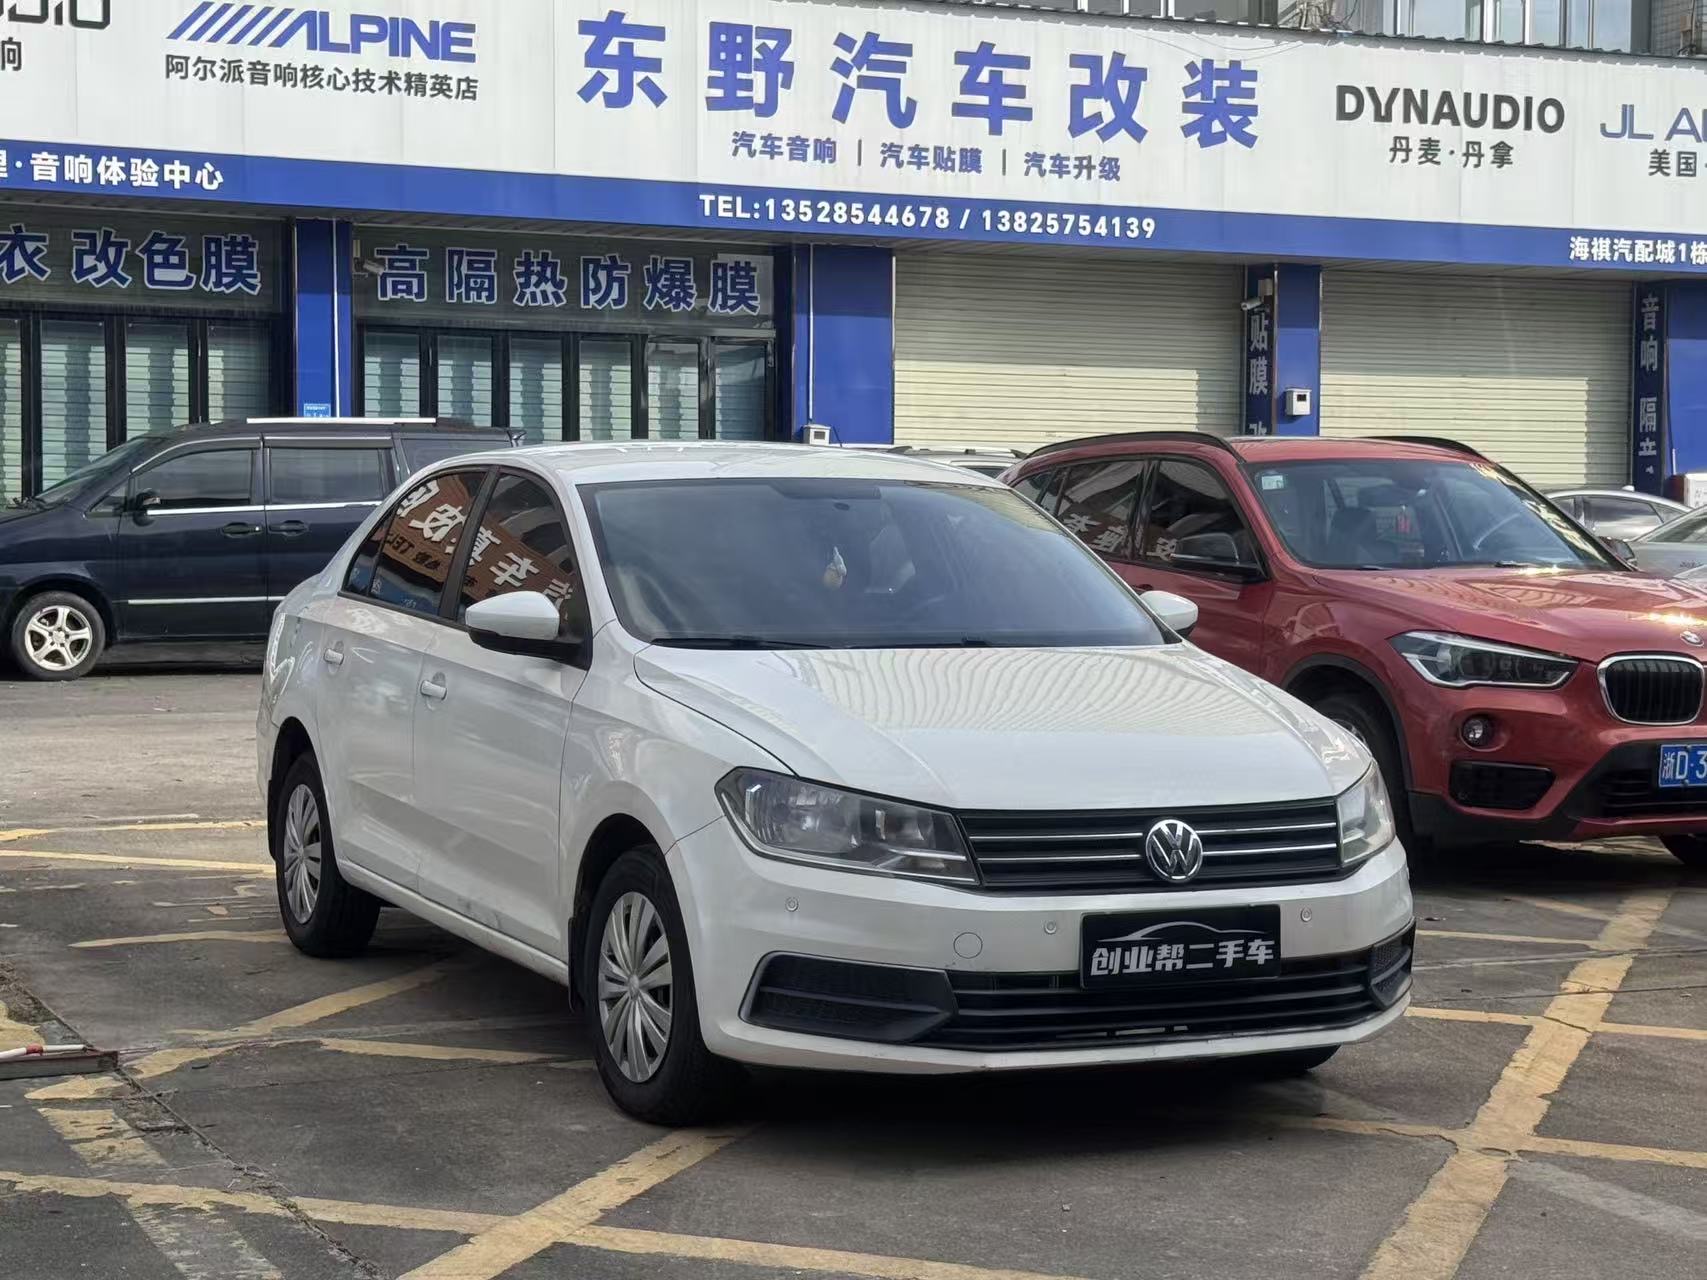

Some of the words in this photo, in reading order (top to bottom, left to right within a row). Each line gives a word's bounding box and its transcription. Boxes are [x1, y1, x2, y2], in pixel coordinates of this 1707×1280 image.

[268, 9, 476, 63] ALPINE
[165, 54, 478, 101] 阿尔派音响核心技术精英店
[576, 10, 1259, 151] 东野汽车改装
[1336, 85, 1565, 133] DYNAUDIO
[1600, 104, 1654, 140] JL
[731, 131, 837, 164] 汽车音响
[880, 143, 983, 174] 汽车贴膜
[1023, 151, 1121, 182] 汽车升级
[1390, 136, 1514, 169] 丹麦·丹拿
[699, 194, 950, 230] TEL:13528544678
[981, 209, 1156, 239] 13825754139
[374, 243, 762, 315] 高隔热防爆膜
[1640, 293, 1660, 371] 音响
[1090, 938, 1275, 976] 创业帮二手车
